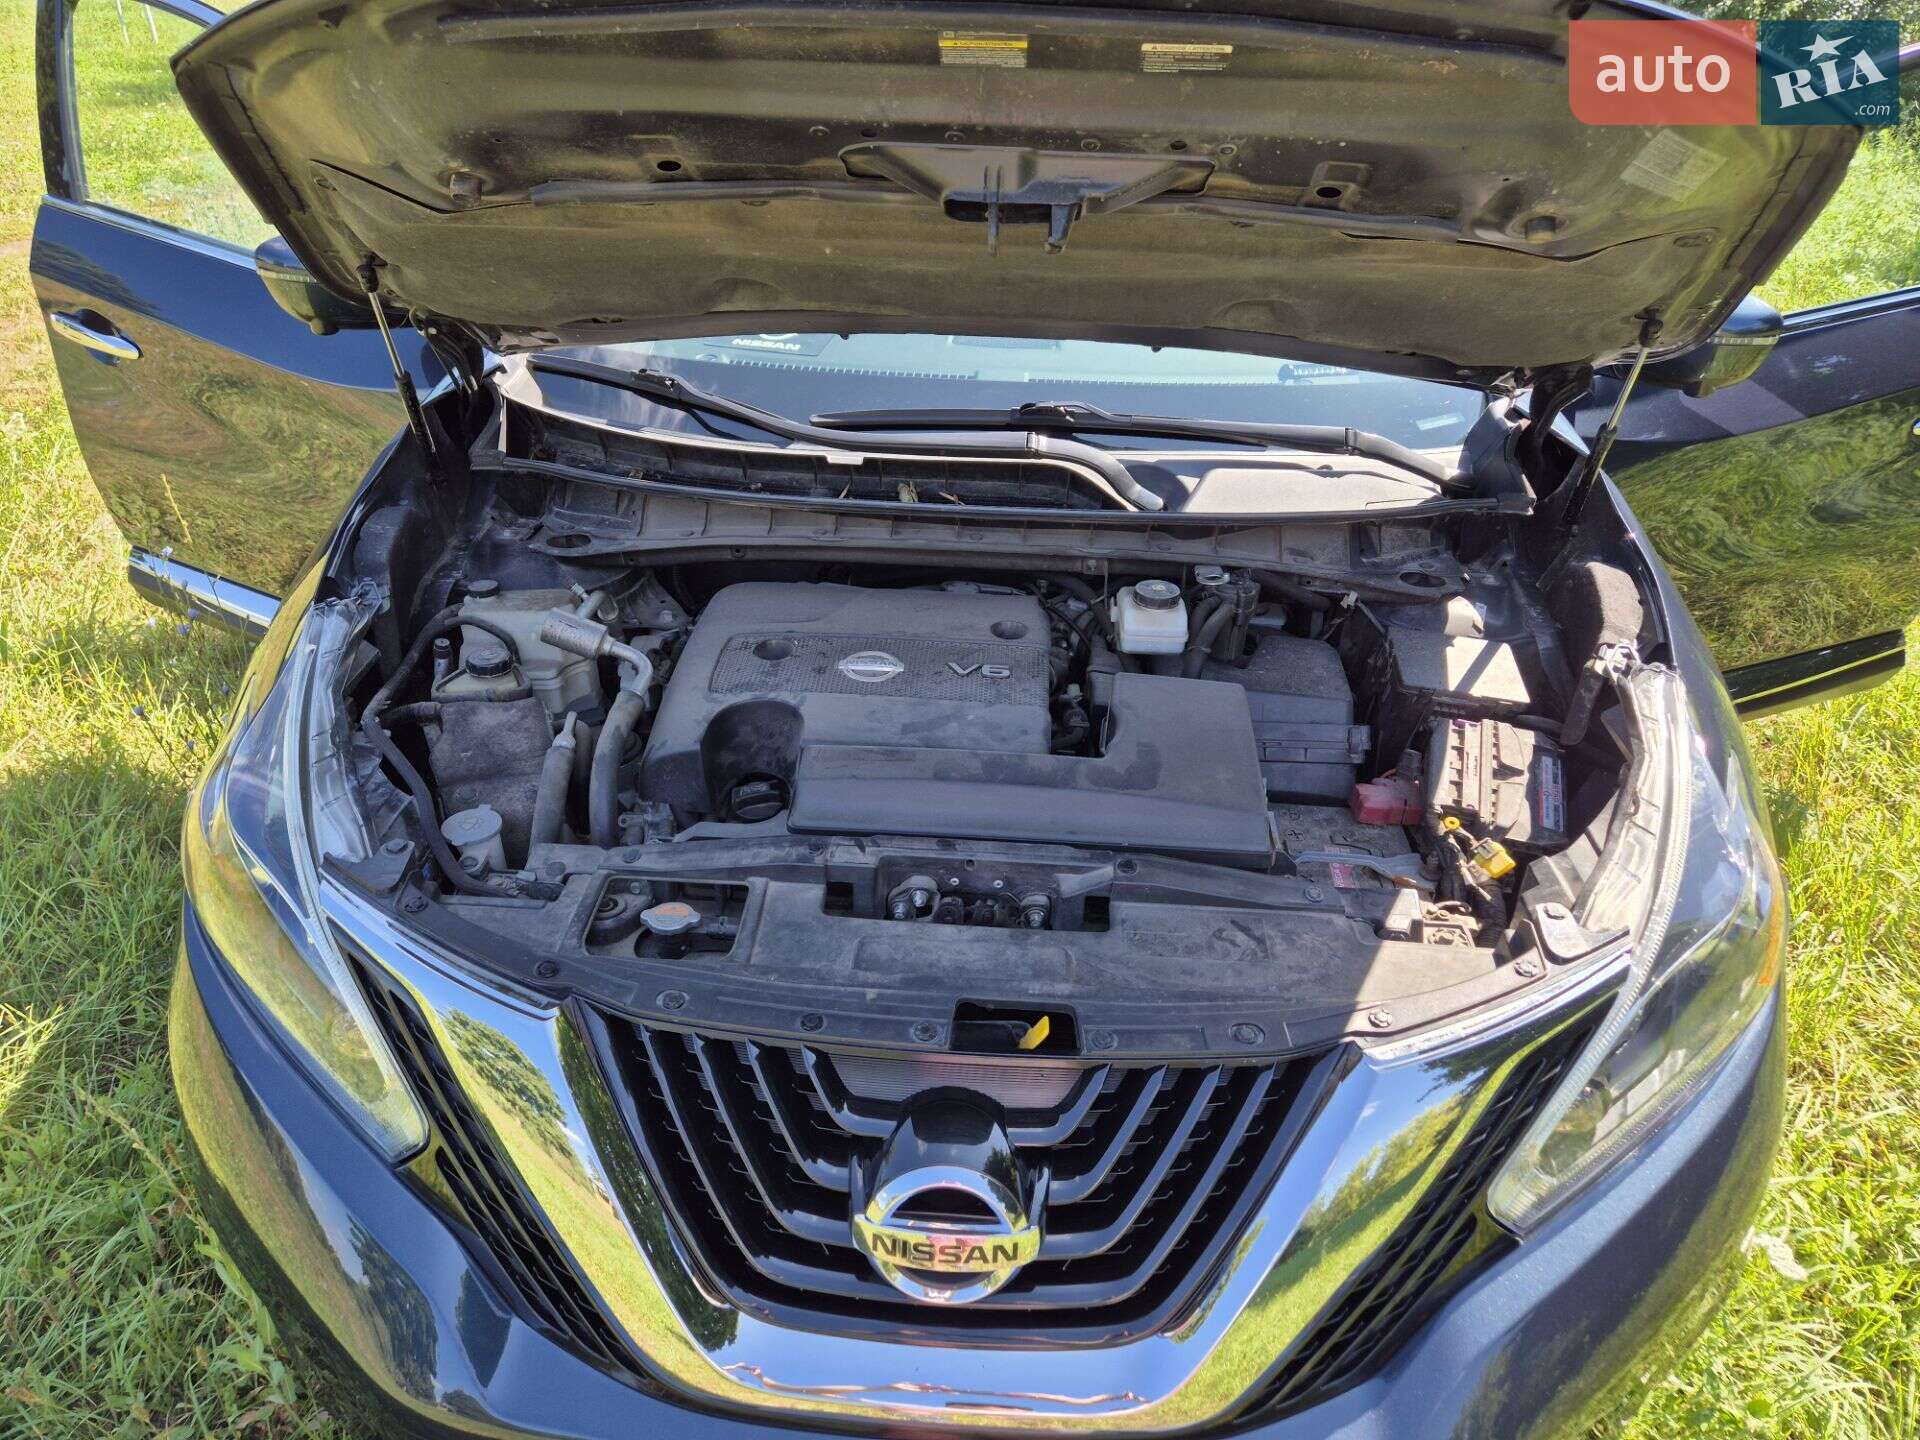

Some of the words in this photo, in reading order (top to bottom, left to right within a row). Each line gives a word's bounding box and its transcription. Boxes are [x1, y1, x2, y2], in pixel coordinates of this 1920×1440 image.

[731, 338, 801, 350] NISSAN
[947, 662, 1011, 678] V6
[871, 1233, 1019, 1265] NISSAN
